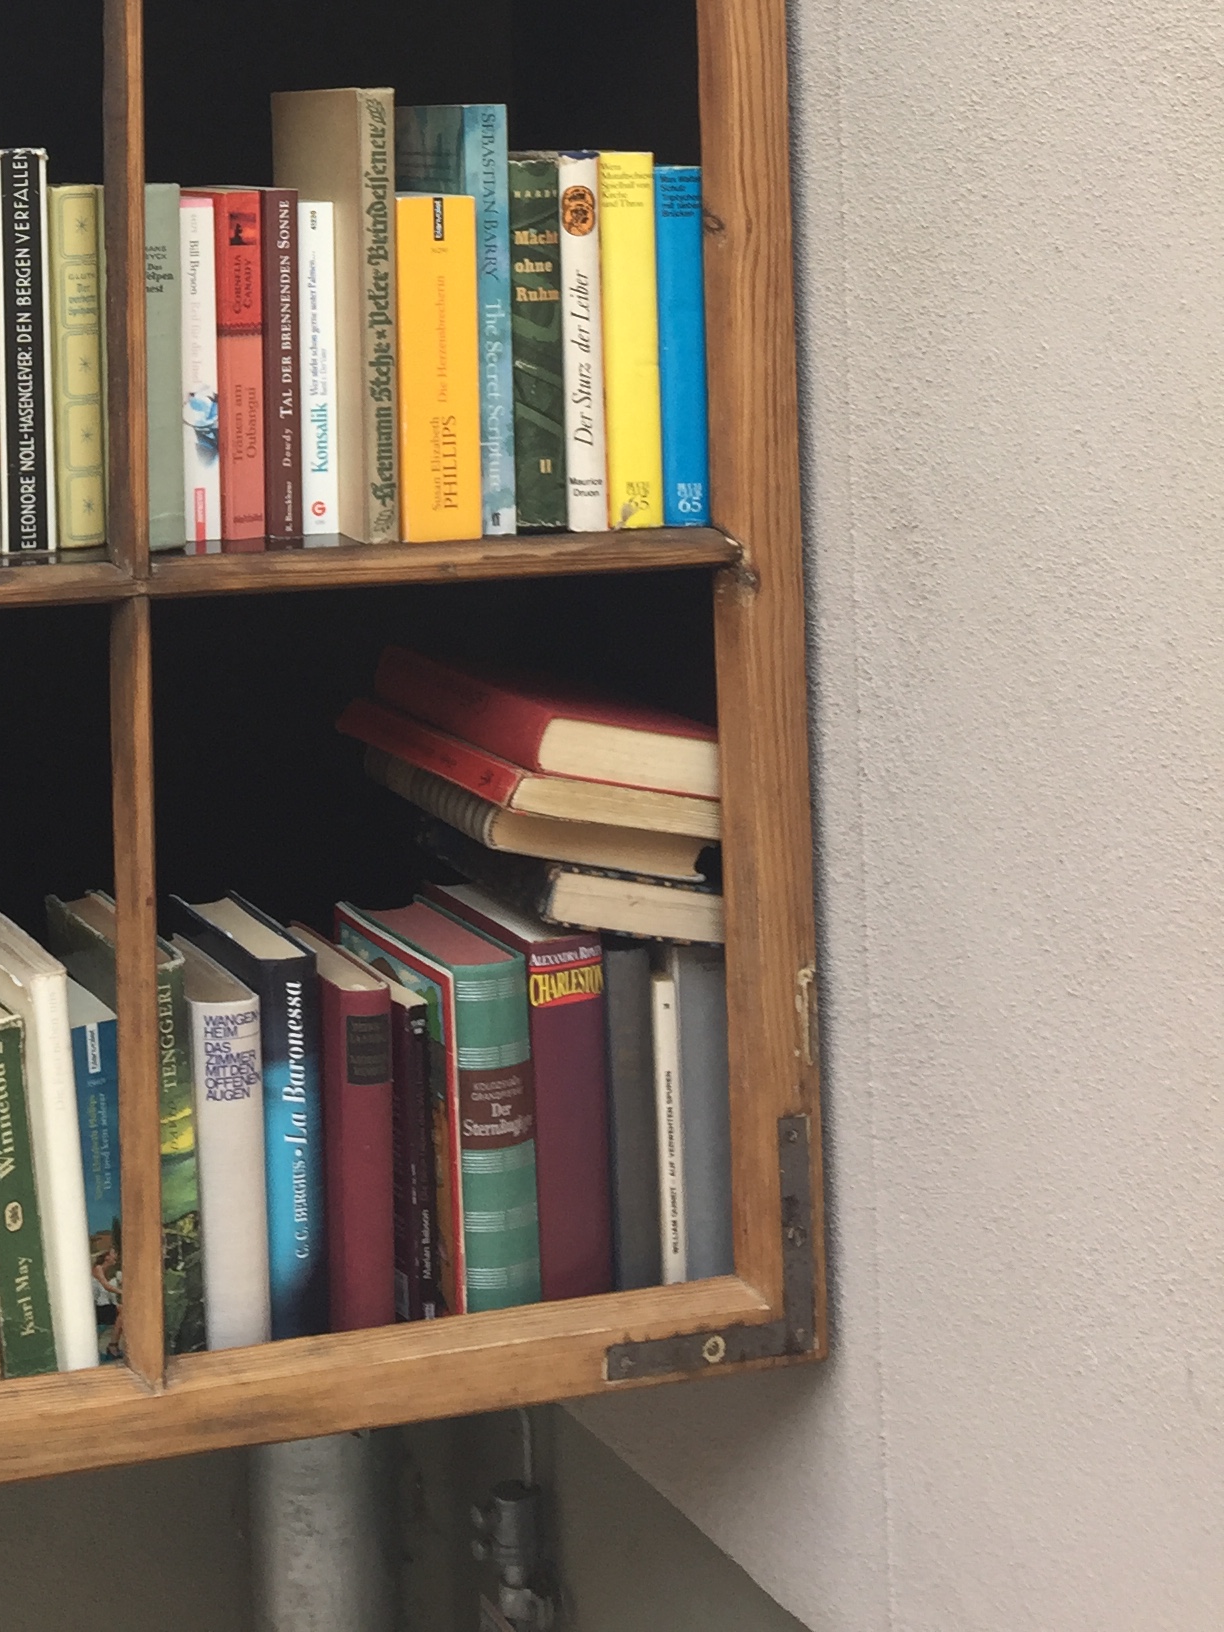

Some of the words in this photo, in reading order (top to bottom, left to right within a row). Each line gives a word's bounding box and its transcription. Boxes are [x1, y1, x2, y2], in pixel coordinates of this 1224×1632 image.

[480, 112, 499, 214] SEBASTIAN
[12, 148, 30, 244] VERFALLEN
[276, 199, 292, 249] SONNE
[514, 229, 559, 245] Macht
[481, 219, 501, 283] BARRY
[513, 258, 553, 273] ohne
[14, 247, 33, 307] BERGEN
[186, 260, 200, 295] Bryson
[516, 287, 560, 301] Ruhm
[278, 254, 293, 350] BRENNENDEN
[567, 269, 591, 322] Leiber
[15, 312, 33, 343] DEN
[484, 298, 505, 337] The
[570, 324, 592, 354] der
[280, 356, 293, 383] DER
[485, 340, 504, 399] Secret
[570, 362, 593, 409] Sturz
[279, 388, 294, 419] TAL
[309, 402, 329, 474] Konsalik
[429, 416, 442, 473] Elizabeth
[573, 411, 595, 446] Der
[441, 414, 459, 509] PHILLIPS
[479, 403, 505, 494] Scripture
[431, 476, 443, 511] Susan
[569, 477, 603, 486] Maurice
[573, 488, 600, 497] Druon
[19, 476, 38, 549] ELEONORE
[528, 963, 605, 1007] CHARLESTON
[203, 1027, 239, 1042] HEIM
[204, 1041, 232, 1055] DAS
[281, 980, 307, 1105] Baronessa
[205, 1050, 257, 1070] ZIMMER
[206, 1087, 251, 1102] AUGEN
[664, 1070, 674, 1105] SPUREN
[282, 1111, 308, 1145] La
[490, 1103, 512, 1118] Der
[667, 1159, 677, 1177] AUF
[291, 1160, 309, 1223] BERGIUS
[670, 1220, 680, 1255] WILLIAM
[14, 1256, 34, 1292] May
[16, 1296, 37, 1337] Karl
